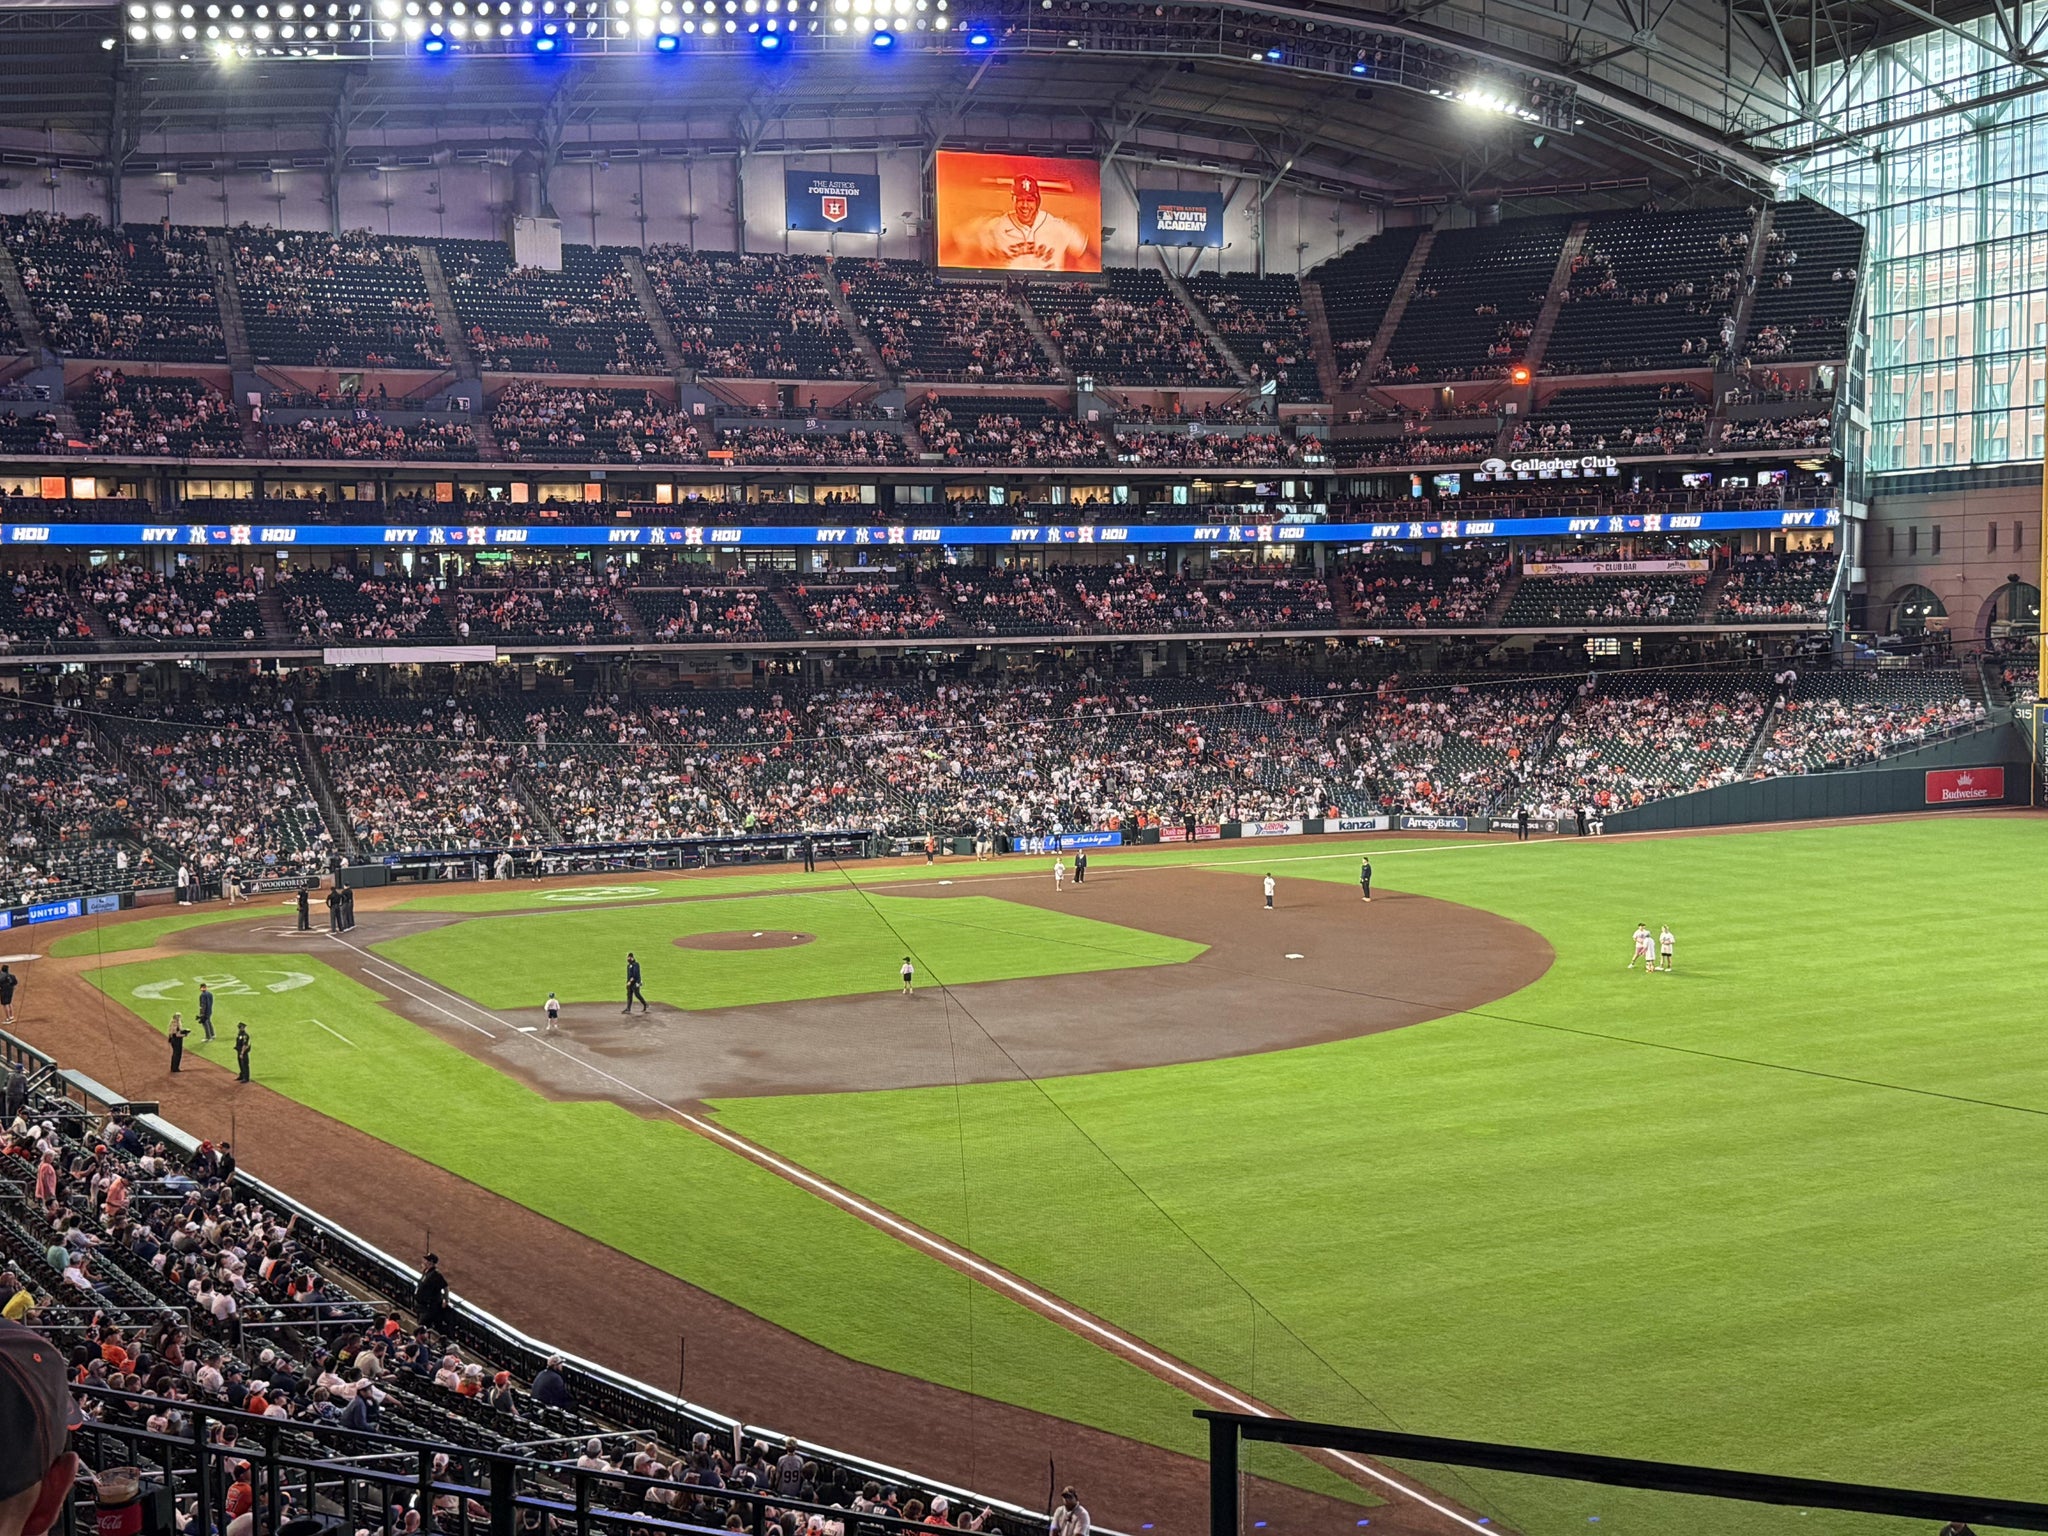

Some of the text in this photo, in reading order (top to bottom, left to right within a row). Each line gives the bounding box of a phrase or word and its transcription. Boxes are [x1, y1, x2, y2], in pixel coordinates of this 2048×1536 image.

[808, 187, 860, 195] FOUNDATION
[829, 181, 855, 189] ASTROS
[1173, 211, 1207, 221] YOUTH
[1157, 220, 1207, 231] ACADEMY
[1511, 458, 1578, 471] Gallagher
[1581, 456, 1617, 468] Club
[1569, 519, 1599, 531] NYY
[1670, 516, 1701, 527] HOU
[1782, 512, 1814, 525] NYY
[12, 527, 49, 541] HOU
[142, 528, 177, 541] NYY
[261, 528, 296, 541] HOU
[816, 530, 846, 541] NYY
[913, 529, 940, 541] HOU
[1011, 529, 1039, 540] NYY
[1101, 528, 1127, 540] HOU
[1194, 528, 1220, 539] NYY
[1279, 527, 1304, 539] HOU
[1371, 525, 1399, 536] NYY
[1465, 522, 1494, 534] HOU
[384, 529, 417, 541] NYY
[495, 530, 527, 542] HOU
[609, 530, 640, 541] NYY
[711, 530, 741, 541] HOU
[1605, 563, 1622, 571] CLUB
[2014, 708, 2032, 719] 315
[1942, 788, 1987, 800] Budweiser
[1338, 819, 1376, 830] kanzal
[1407, 817, 1460, 830] AmegyBank
[30, 906, 67, 919] UNITED
[783, 1470, 799, 1483] 99
